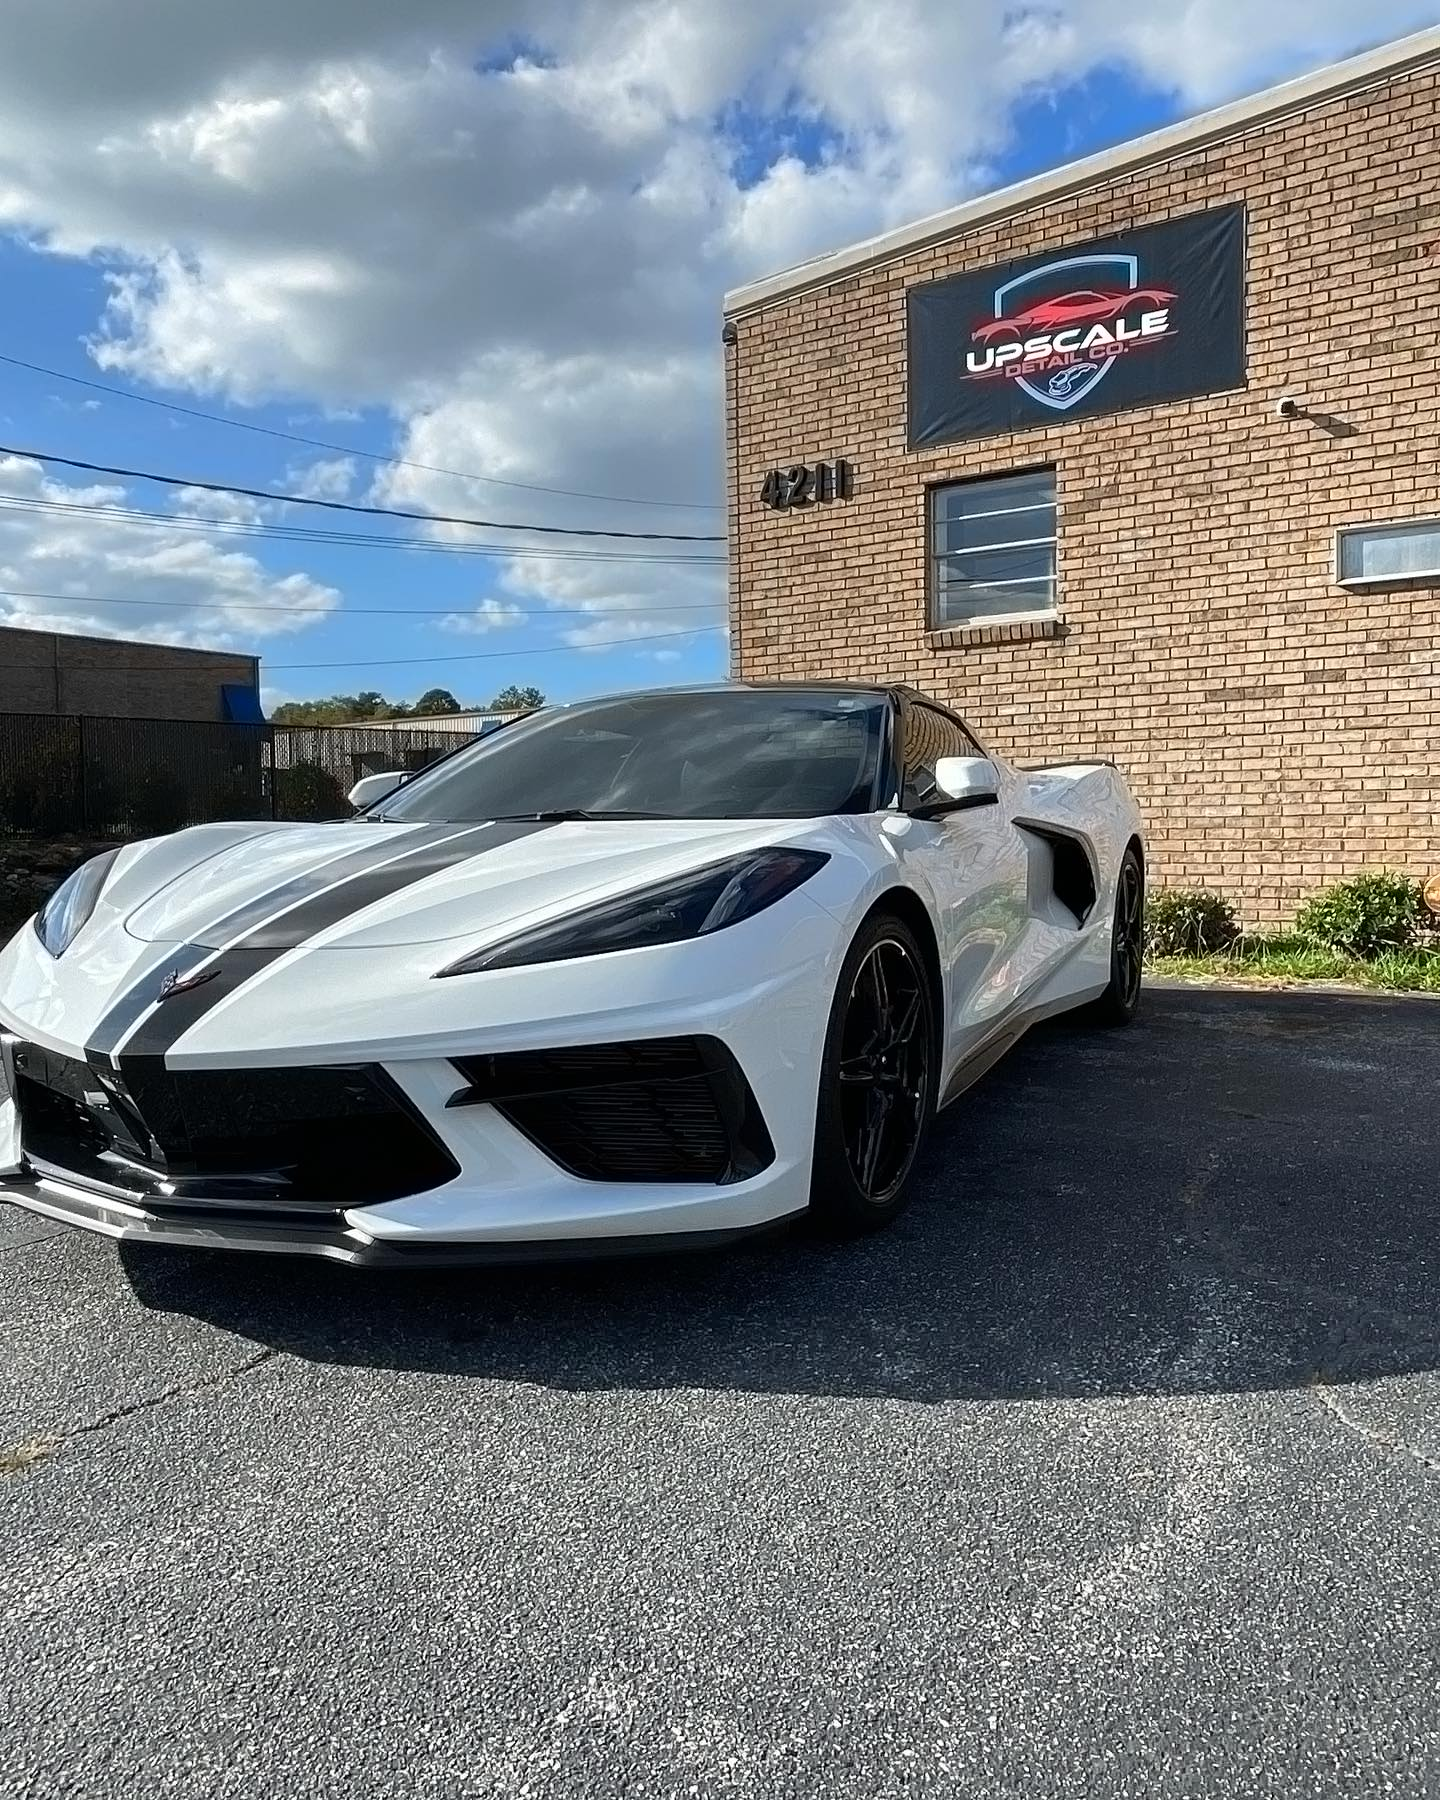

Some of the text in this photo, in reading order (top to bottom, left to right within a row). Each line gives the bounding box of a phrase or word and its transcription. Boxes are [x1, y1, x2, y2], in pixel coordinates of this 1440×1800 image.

[966, 308, 1170, 373] UPSCALE
[1004, 341, 1129, 379] DETAIL CO.
[760, 459, 852, 511] 4211
